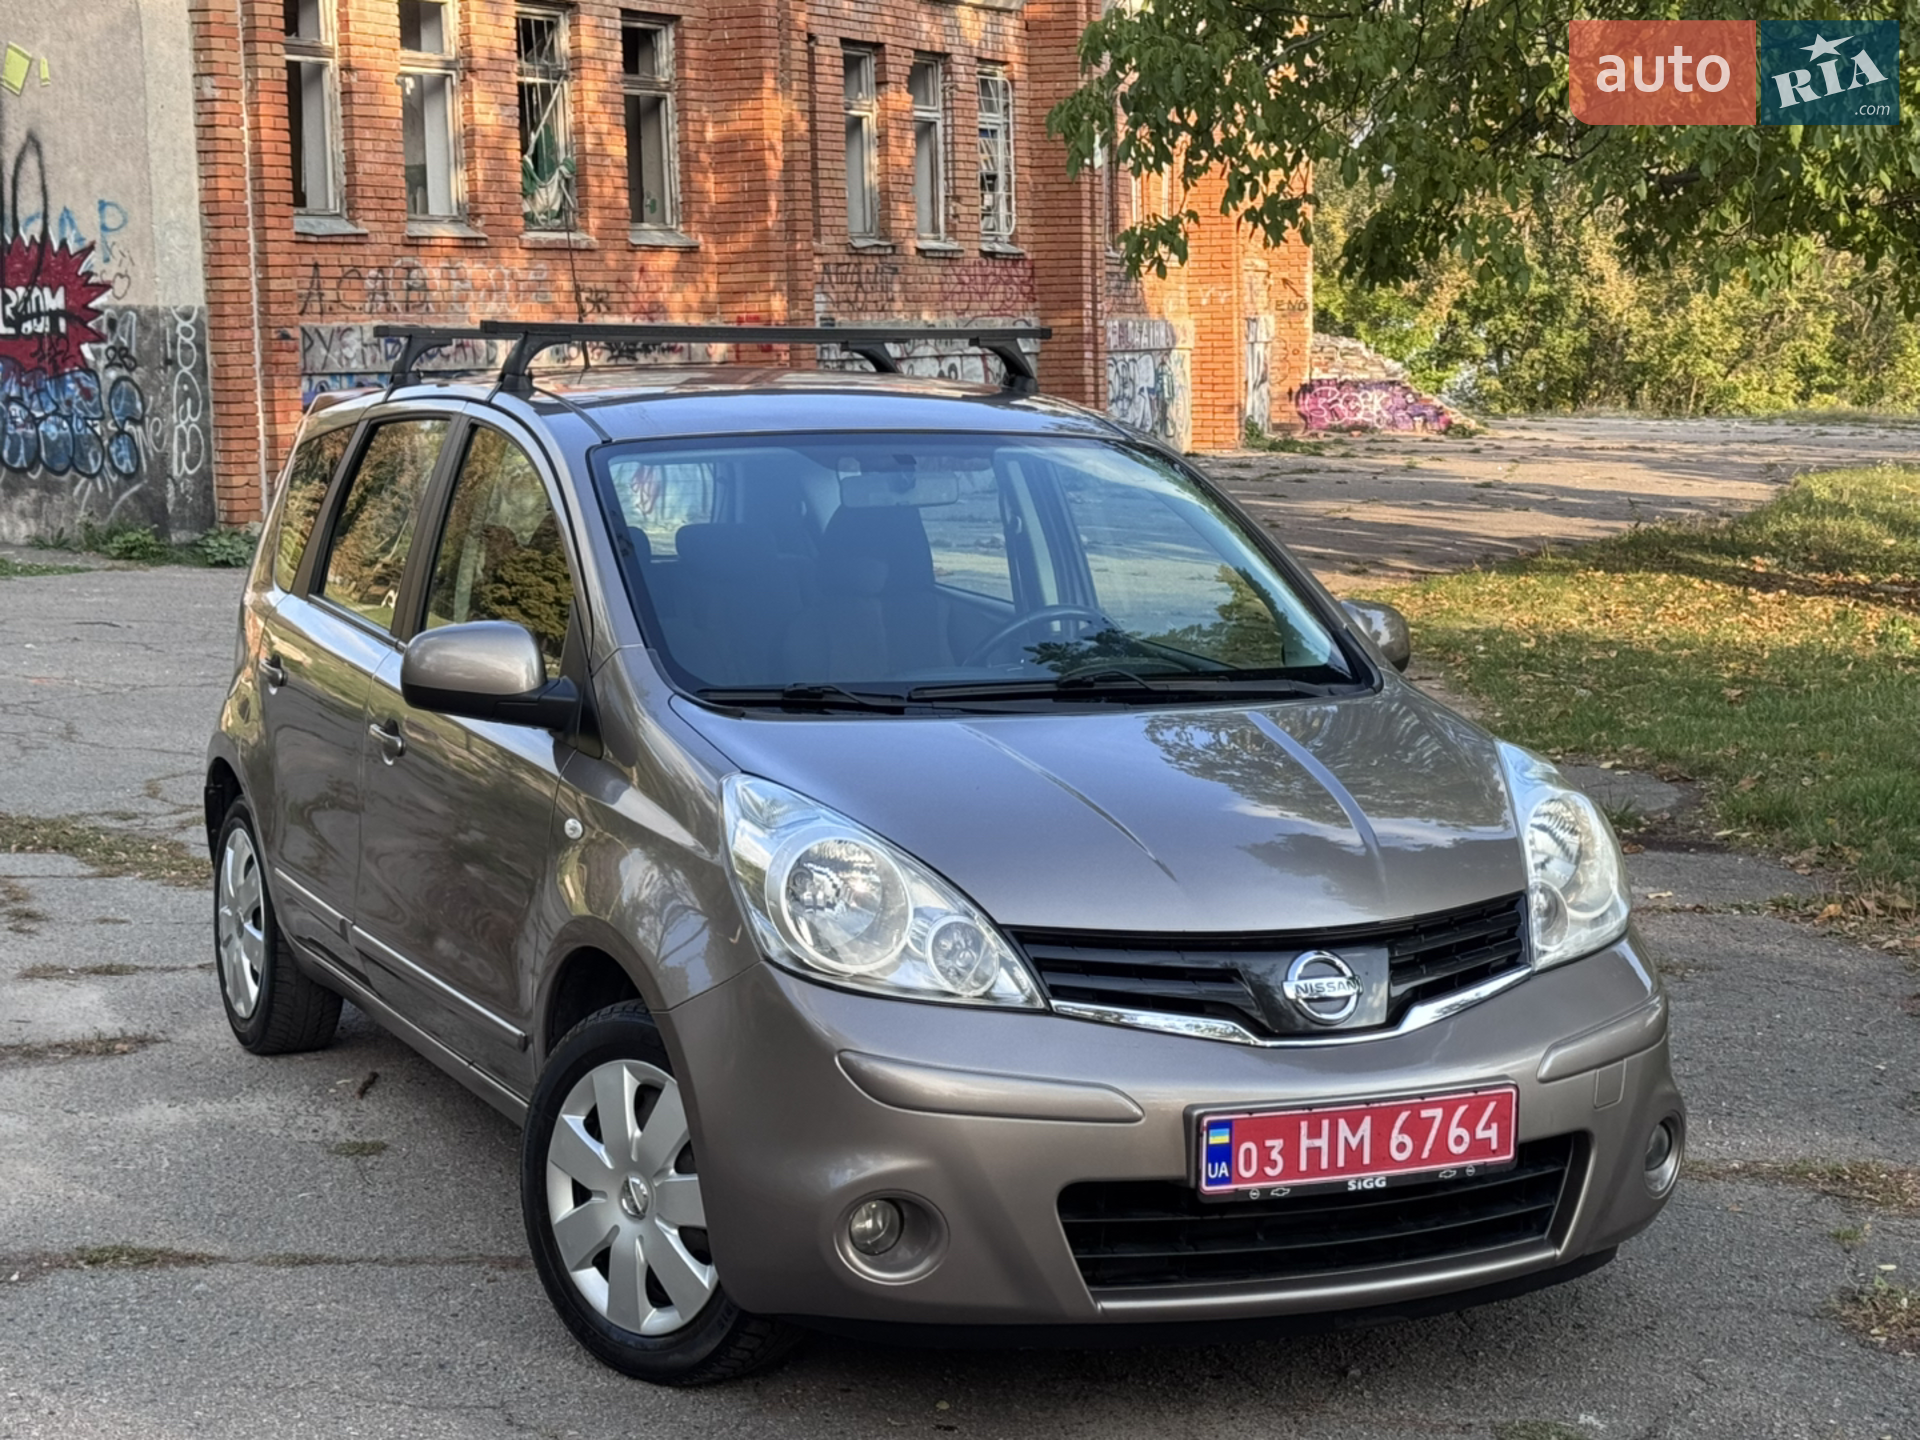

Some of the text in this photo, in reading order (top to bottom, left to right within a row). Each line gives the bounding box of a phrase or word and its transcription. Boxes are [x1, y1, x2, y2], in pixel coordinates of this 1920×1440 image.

[1294, 980, 1358, 996] NISSAN
[1238, 1101, 1498, 1178] 03 HM 6764
[1207, 1162, 1230, 1179] UA
